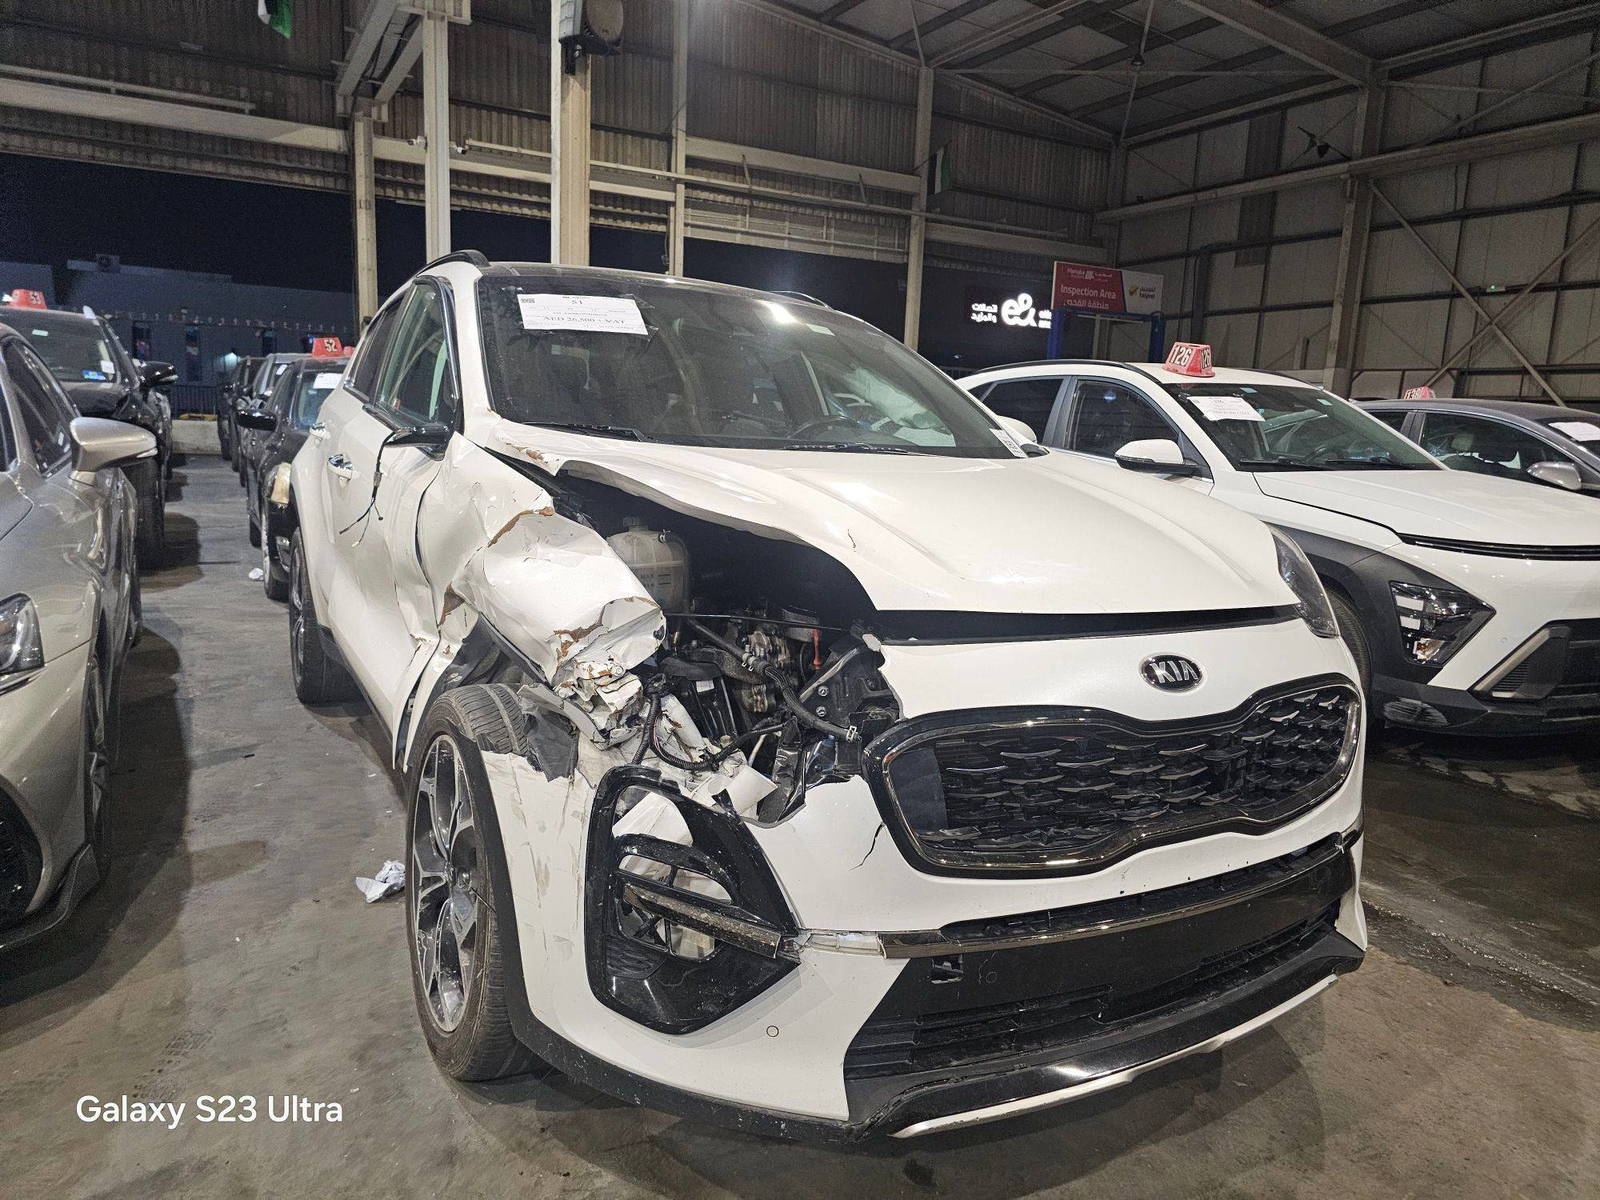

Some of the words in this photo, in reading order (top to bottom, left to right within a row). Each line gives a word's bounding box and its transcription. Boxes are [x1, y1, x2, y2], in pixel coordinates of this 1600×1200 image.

[1060, 284, 1098, 297] Inspection
[1100, 289, 1117, 299] Area
[324, 339, 338, 352] 52
[1168, 345, 1192, 366] 126
[1149, 660, 1199, 684] KIA
